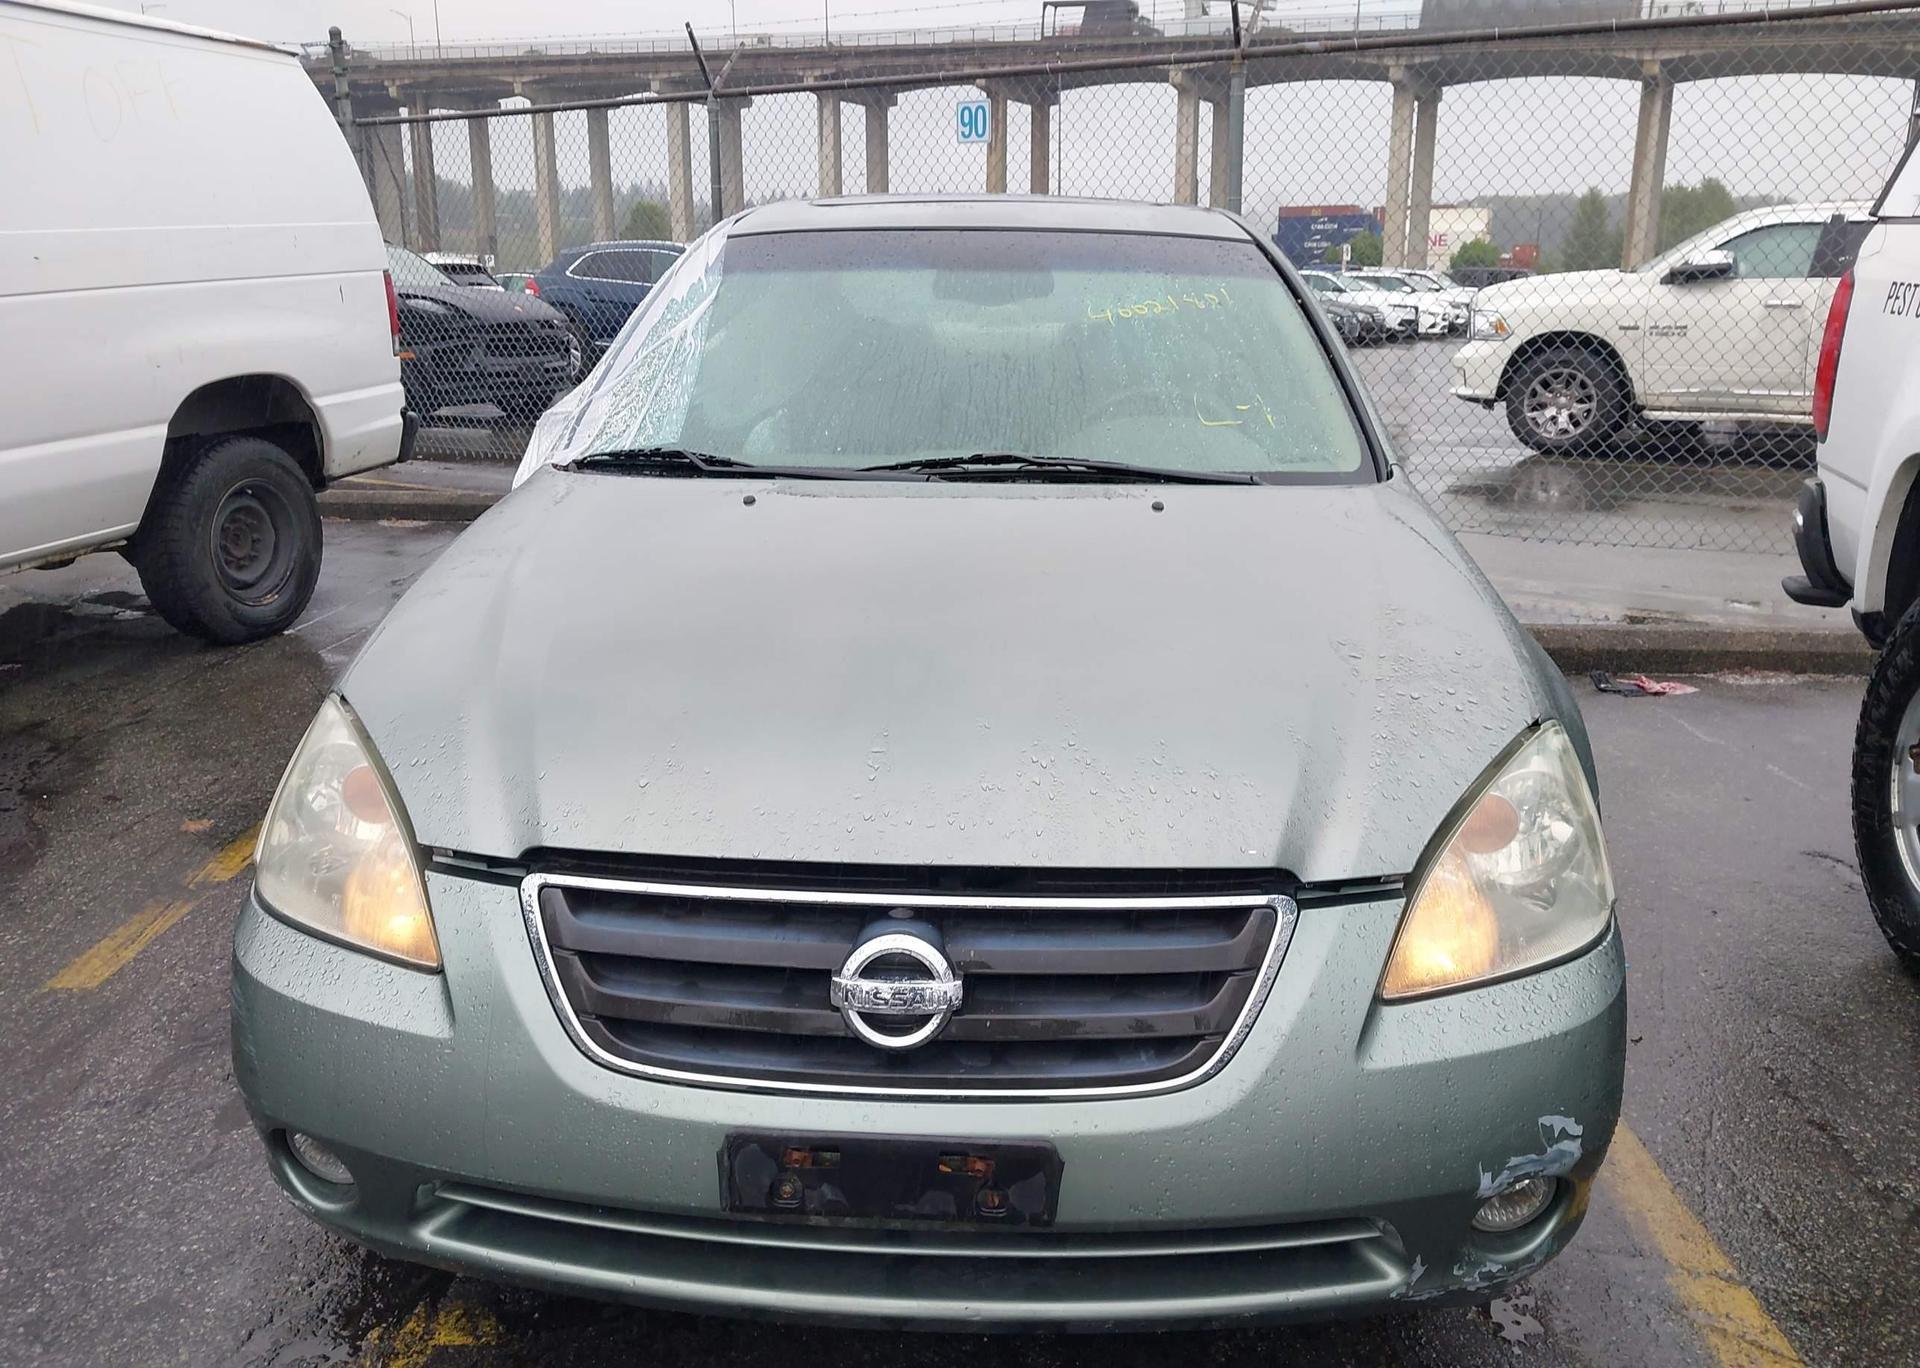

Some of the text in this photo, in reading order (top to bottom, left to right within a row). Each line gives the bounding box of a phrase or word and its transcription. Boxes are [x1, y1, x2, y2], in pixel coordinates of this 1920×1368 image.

[960, 105, 986, 139] 90
[1883, 281, 1920, 317] PEST
[843, 981, 948, 1010] NISSAN
